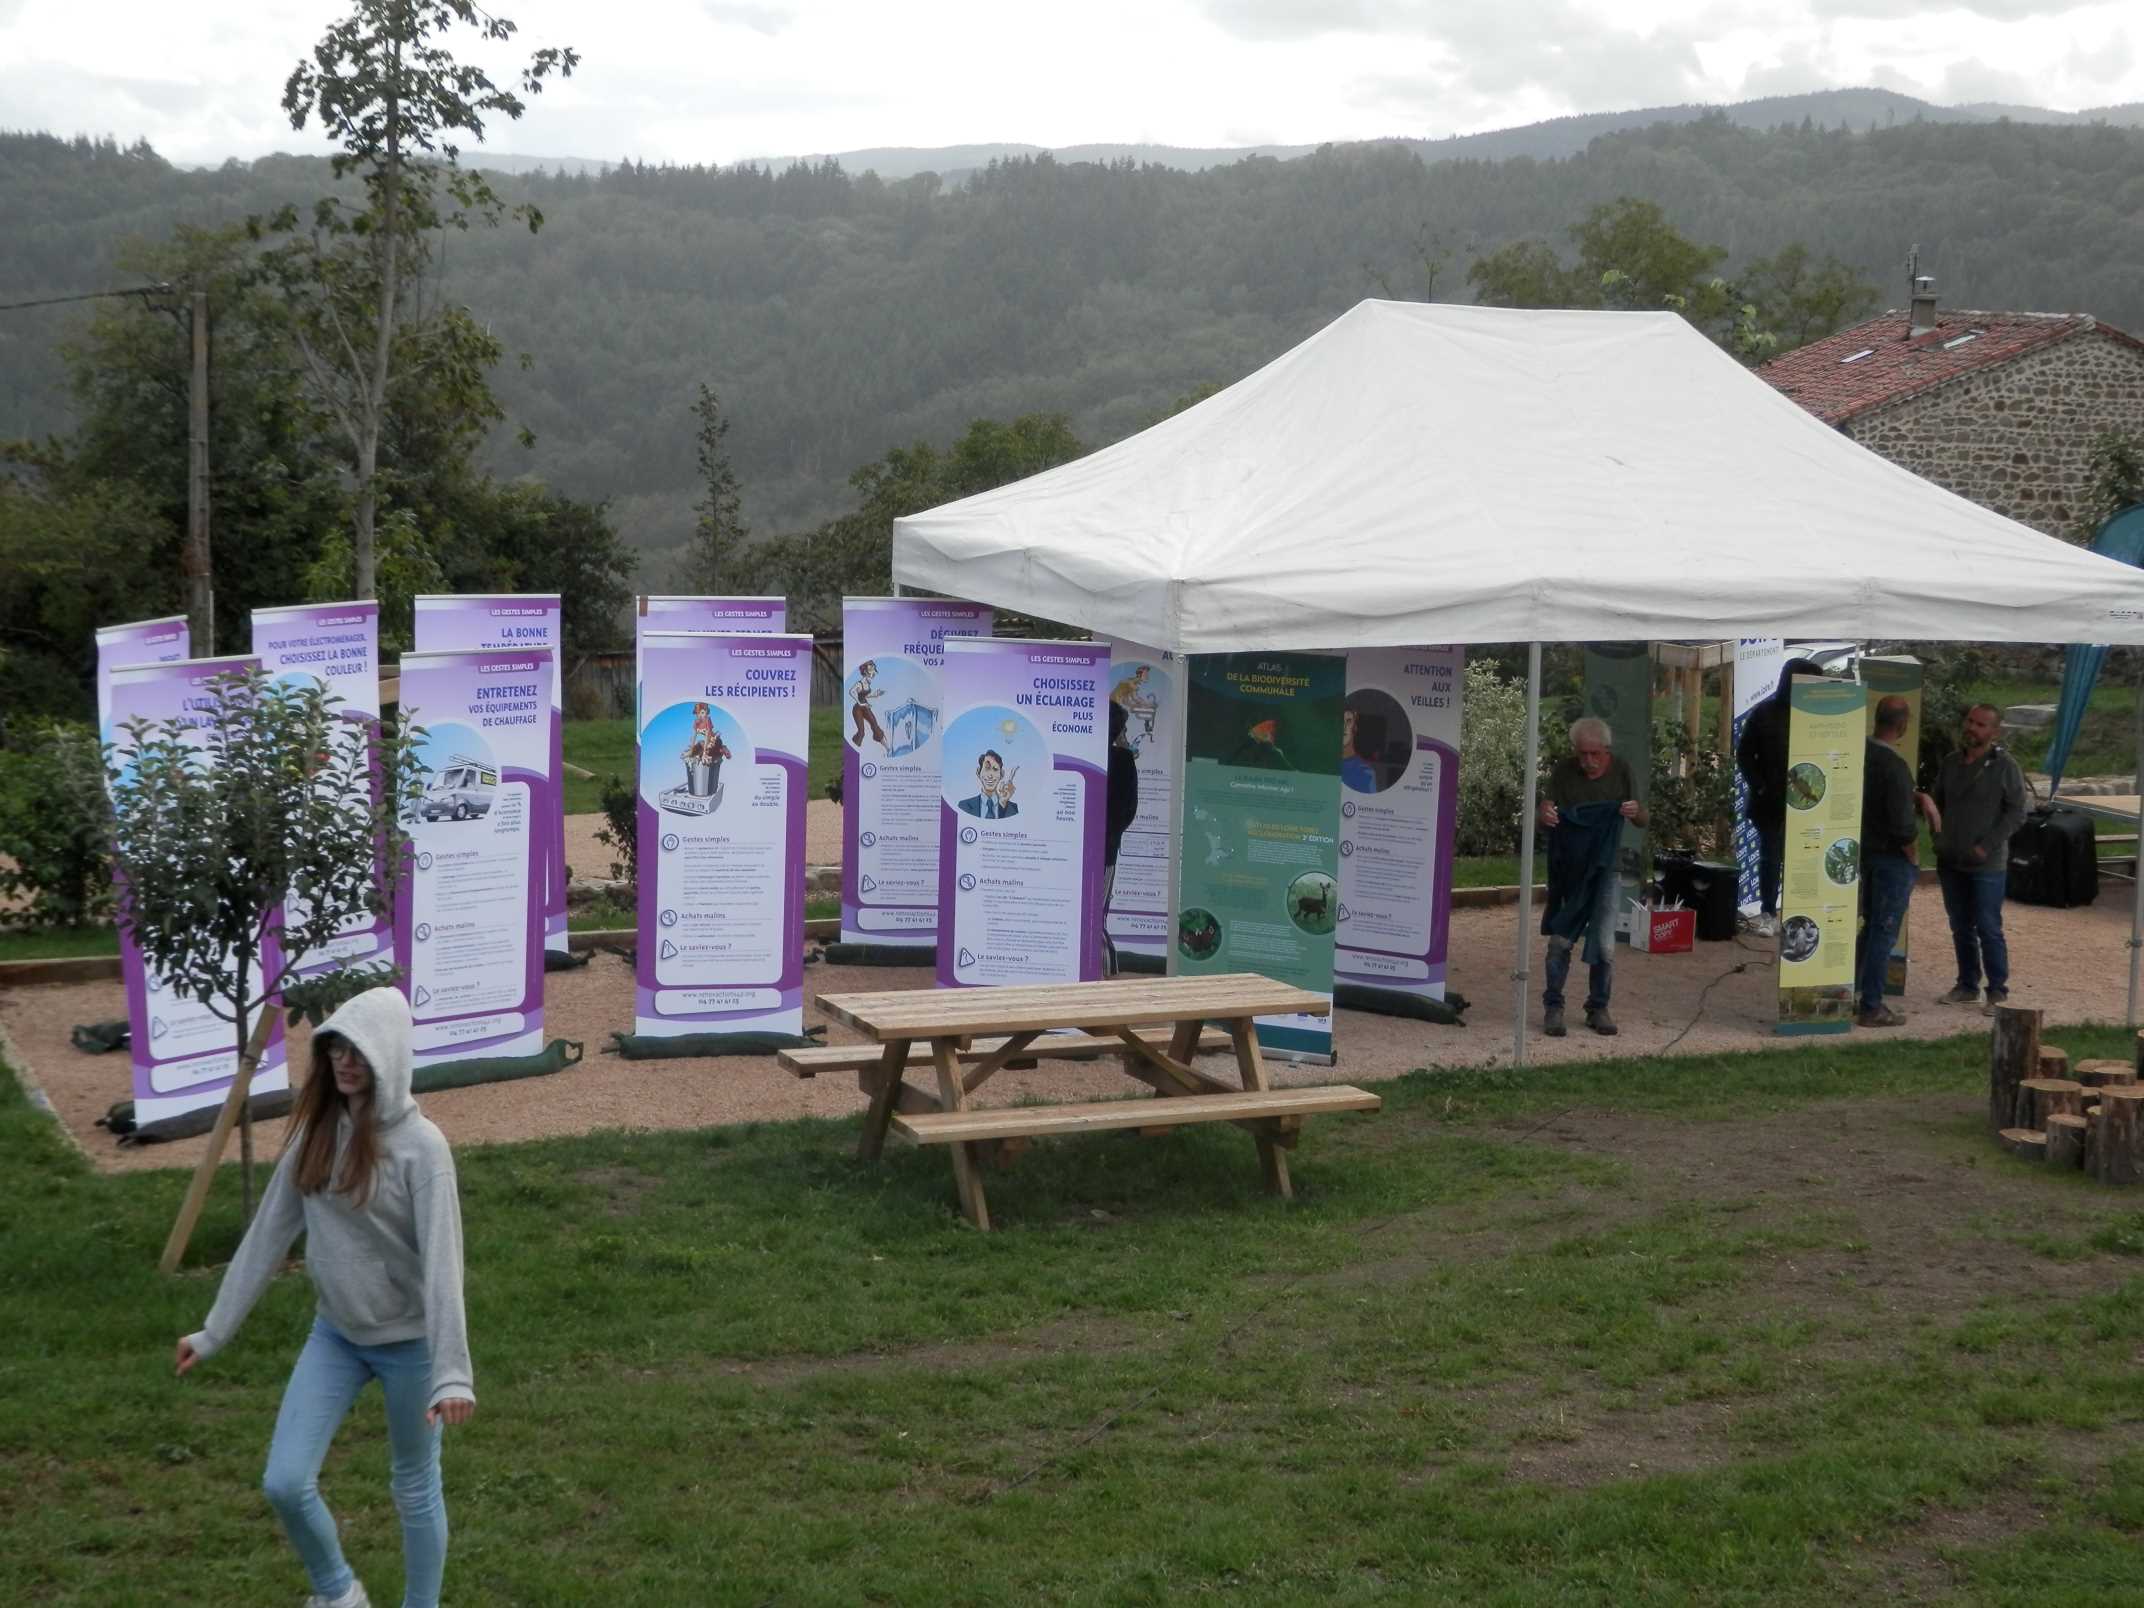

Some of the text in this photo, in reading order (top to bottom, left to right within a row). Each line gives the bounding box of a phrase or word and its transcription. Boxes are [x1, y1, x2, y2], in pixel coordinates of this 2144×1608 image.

[502, 627, 548, 638] LA BONNE
[268, 641, 287, 650] POUR
[904, 641, 944, 656] FRÉQUE
[280, 647, 367, 665] CHOISISSEZ LA BONNE
[743, 649, 765, 657] GESTES
[1030, 655, 1090, 665] LES GESTES SIMPLES
[325, 663, 362, 676] COULEUR
[480, 663, 534, 673] LES GESTES SIMPLES
[1257, 662, 1282, 672] ATLAS
[1404, 664, 1452, 677] ATTENTION
[746, 669, 797, 681] COUVREZ
[1227, 672, 1239, 682] DE
[1239, 673, 1251, 682] LA
[705, 682, 796, 698] LES RÉCIPIENTS !
[1033, 677, 1096, 692] CHOISISSEZ
[1431, 681, 1452, 693] AUX
[476, 684, 538, 699] ENTRETENEZ
[1239, 685, 1296, 697] COMMUNALE
[1016, 690, 1095, 708] UN ÉCLAIRAGE
[1410, 695, 1445, 708] VEILLES
[468, 701, 537, 715] VOS ÉQUIPEMENTS
[482, 714, 537, 727] DE CHAUFFAGE
[1073, 711, 1094, 721] PLUS
[1052, 720, 1093, 734] ÉCONOME
[704, 836, 730, 844] simples
[980, 830, 1028, 840] Gestes simples
[979, 877, 1024, 887] Achats malins
[681, 912, 726, 920] Achats malins
[985, 954, 1024, 962] saviez-vous
